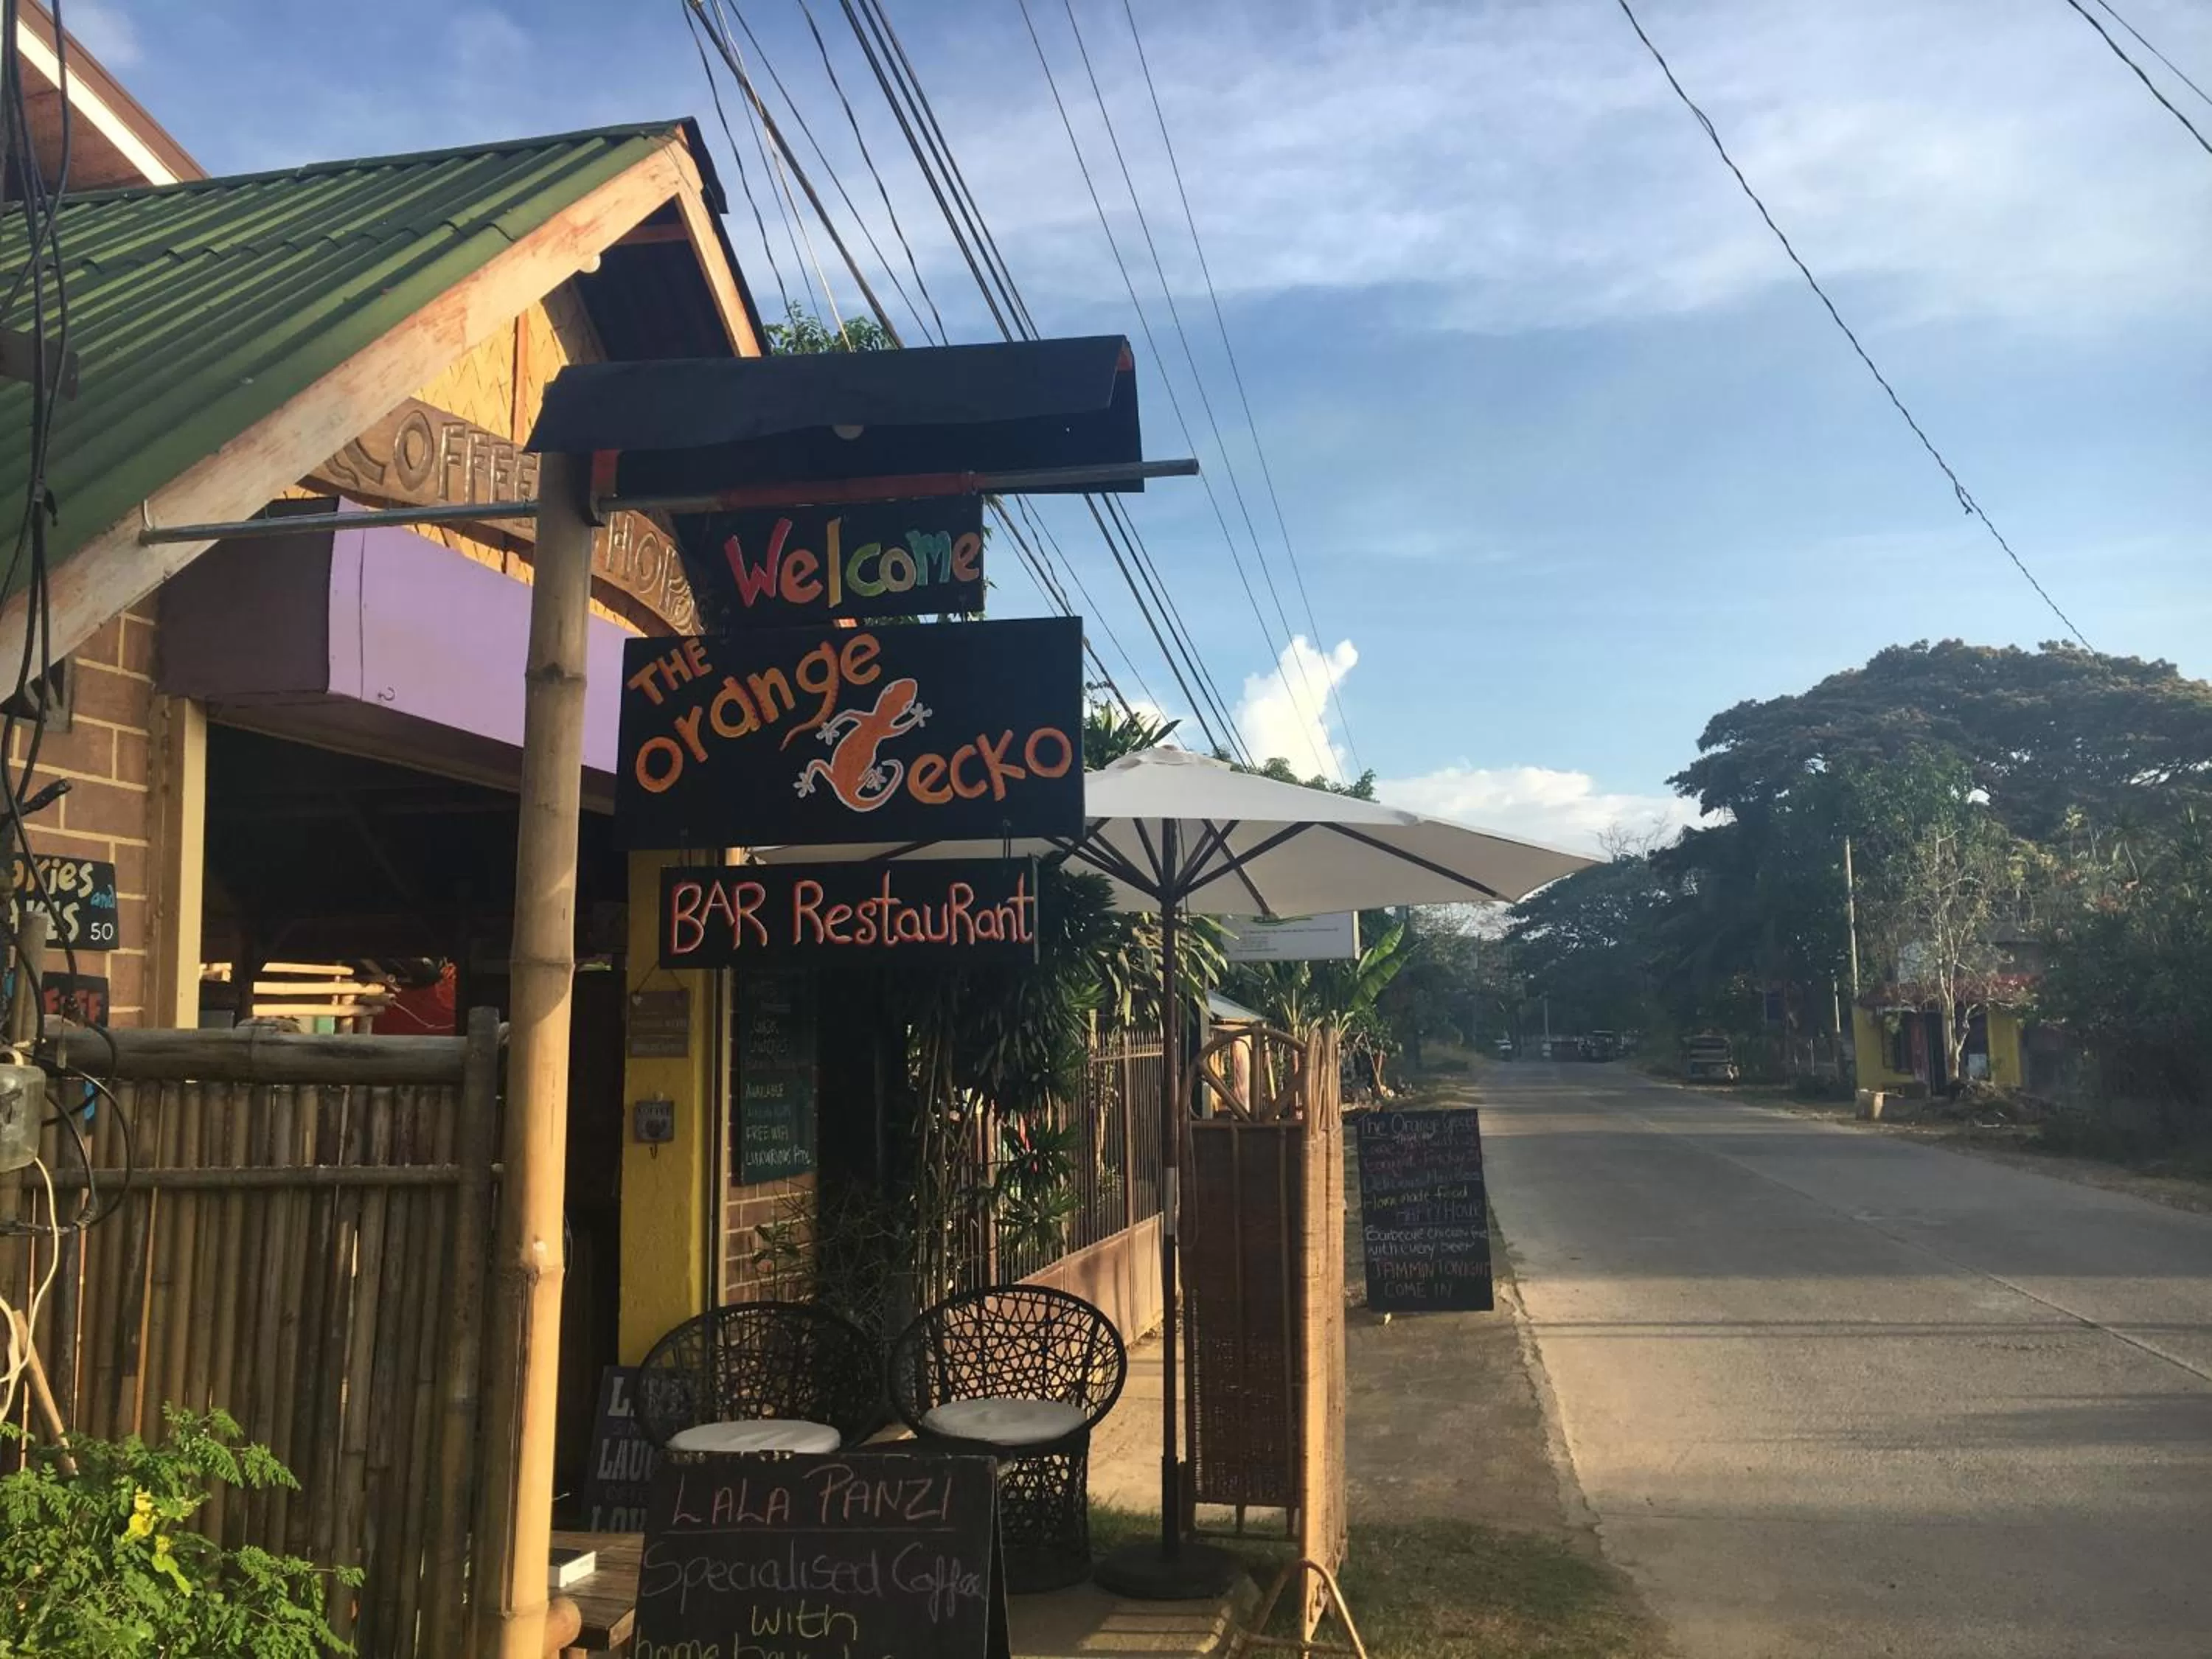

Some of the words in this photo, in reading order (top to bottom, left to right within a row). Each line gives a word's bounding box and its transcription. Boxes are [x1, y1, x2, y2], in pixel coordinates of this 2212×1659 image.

[723, 517, 981, 608] Welcome
[627, 638, 713, 706] THE
[90, 922, 114, 940] 50
[669, 878, 768, 955] BAR
[1384, 1282, 1426, 1298] COME
[1433, 1281, 1450, 1298] IN
[672, 1474, 791, 1525] LALA
[803, 1463, 953, 1525] PANZI
[641, 1540, 883, 1615] Specialised
[751, 1599, 858, 1641] with
